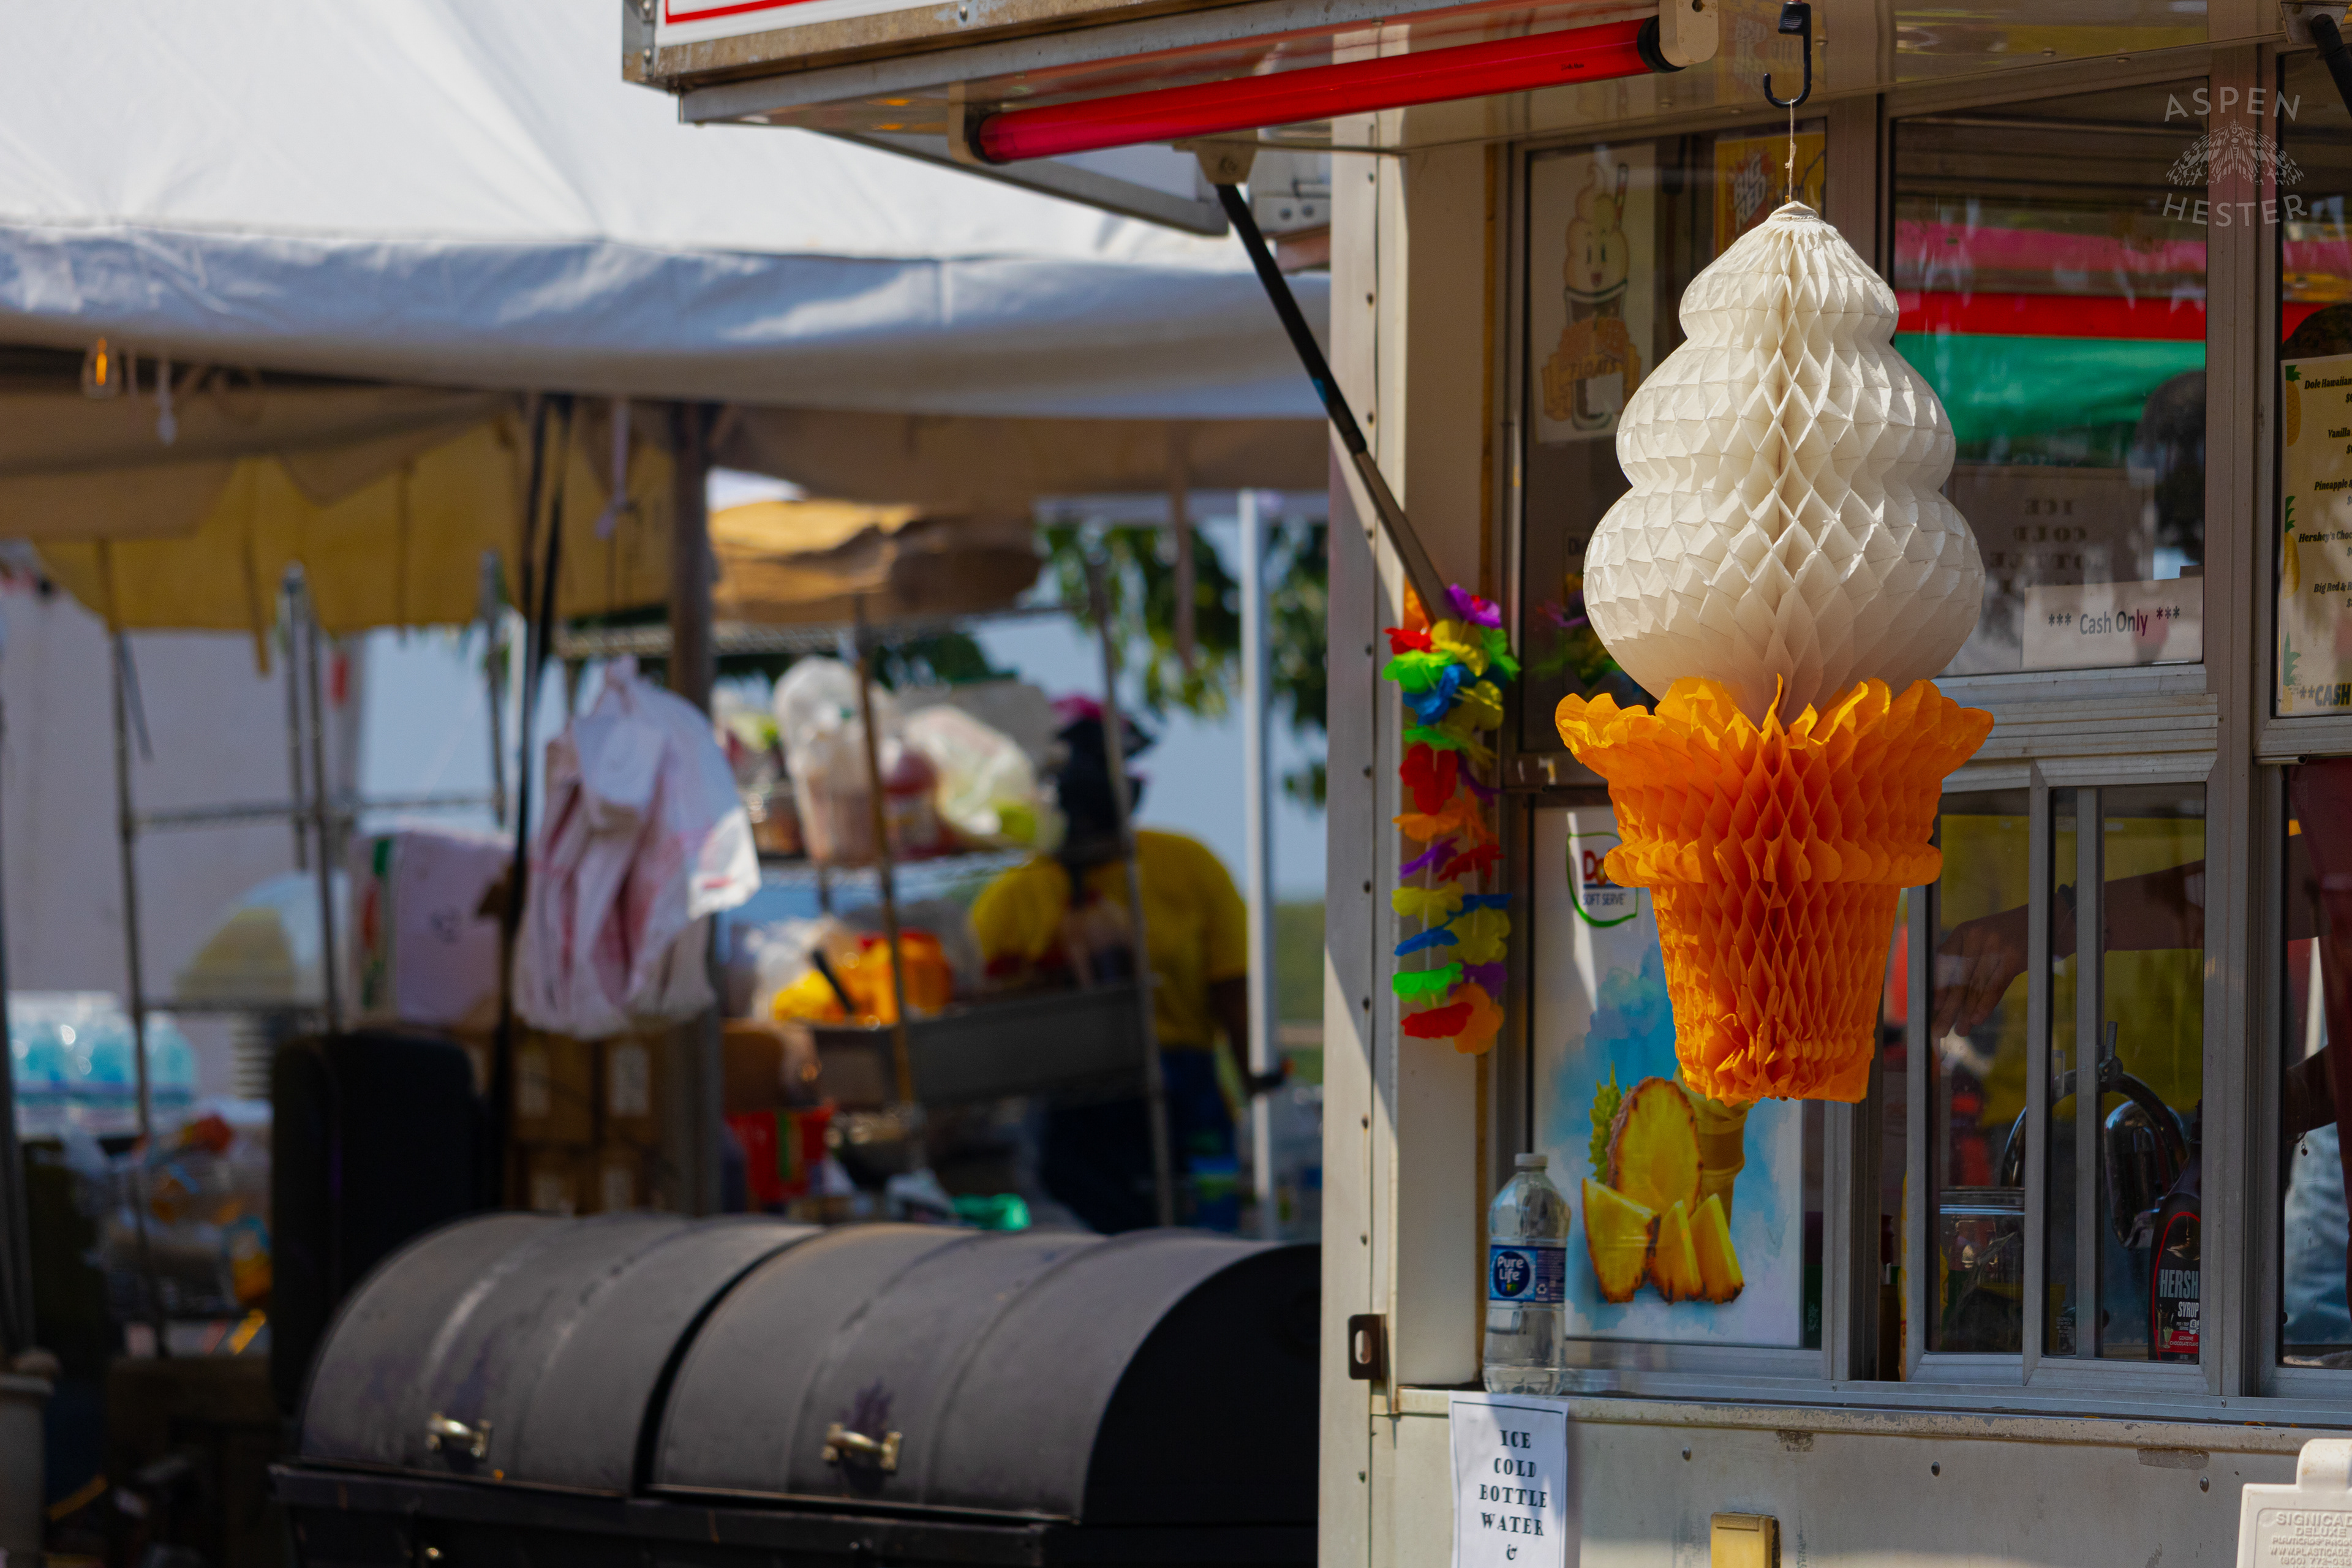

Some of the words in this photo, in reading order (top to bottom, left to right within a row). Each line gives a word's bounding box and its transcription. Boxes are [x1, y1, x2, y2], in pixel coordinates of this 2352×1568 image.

[2304, 379, 2321, 390] Dole
[2328, 427, 2350, 438] Vanilla
[2314, 478, 2348, 492] Pineapple
[2298, 532, 2335, 543] Hershey's
[2313, 582, 2327, 594] Big
[2326, 581, 2340, 592] Red
[2340, 582, 2346, 592] &
[2079, 610, 2112, 635] Cash
[2116, 609, 2148, 636] Only
[1498, 1256, 1524, 1268] Pure
[1499, 1268, 1520, 1283] Life
[2159, 1268, 2199, 1299] HERSH
[2177, 1301, 2199, 1317] SYRUP
[1499, 1430, 1531, 1449] ICE
[1494, 1457, 1537, 1477] COLD
[1479, 1484, 1547, 1508] BOTTLE
[1480, 1512, 1545, 1536] WATER
[2294, 1526, 2347, 1537] DELUXE
